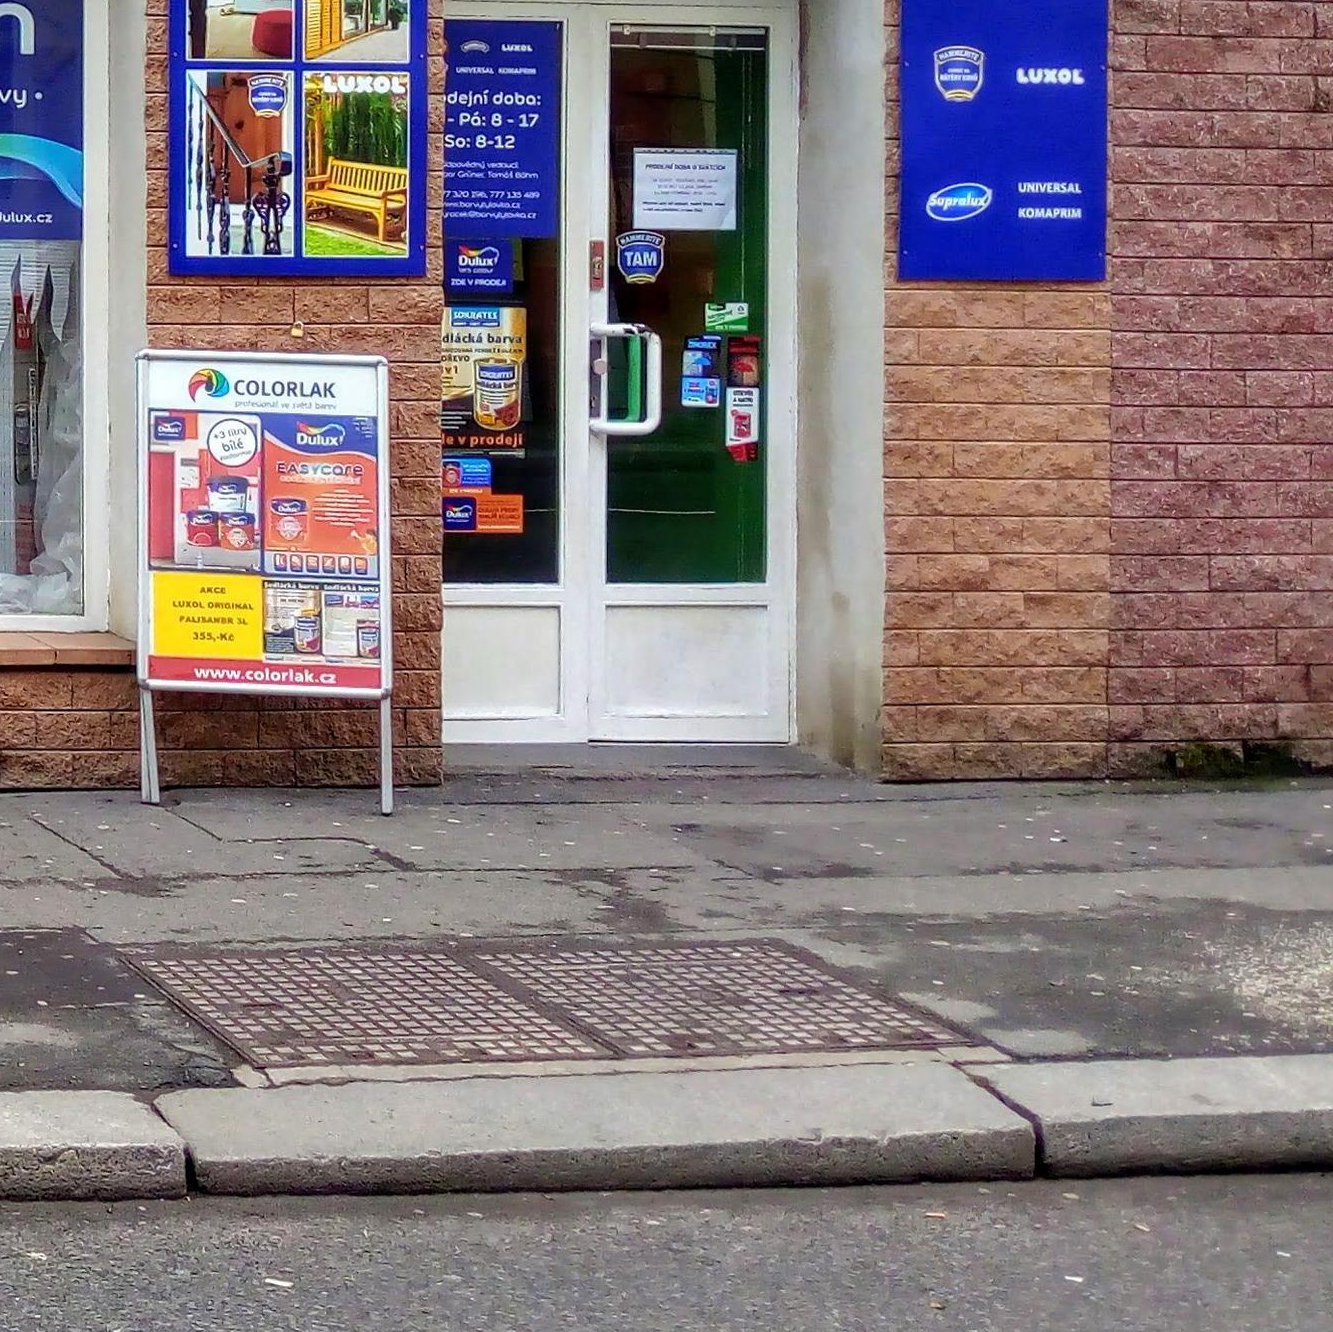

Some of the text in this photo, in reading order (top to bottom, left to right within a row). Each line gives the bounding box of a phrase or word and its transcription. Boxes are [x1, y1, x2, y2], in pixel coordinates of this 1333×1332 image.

[1016, 67, 1085, 85] LUXOL
[324, 76, 406, 93] LUXOL
[493, 92, 541, 106] doba:
[459, 112, 486, 126] Pá:
[491, 113, 502, 127] 8
[518, 114, 539, 127] 17
[444, 134, 515, 149] So: 8-12
[1017, 182, 1082, 194] UNIVERSAL
[1017, 207, 1082, 219] KOMAPRIM
[458, 255, 493, 266] Dulux
[624, 251, 658, 267] TAM
[442, 332, 523, 344] dlácká barva
[234, 380, 336, 399] COLORLAK
[296, 432, 339, 446] Dulux
[458, 436, 466, 445] v
[470, 433, 523, 447] prodeji
[199, 586, 226, 595] AKCE
[172, 601, 254, 611] LUXOL ORIGINAL
[194, 667, 337, 684] www.colorlak.cz
